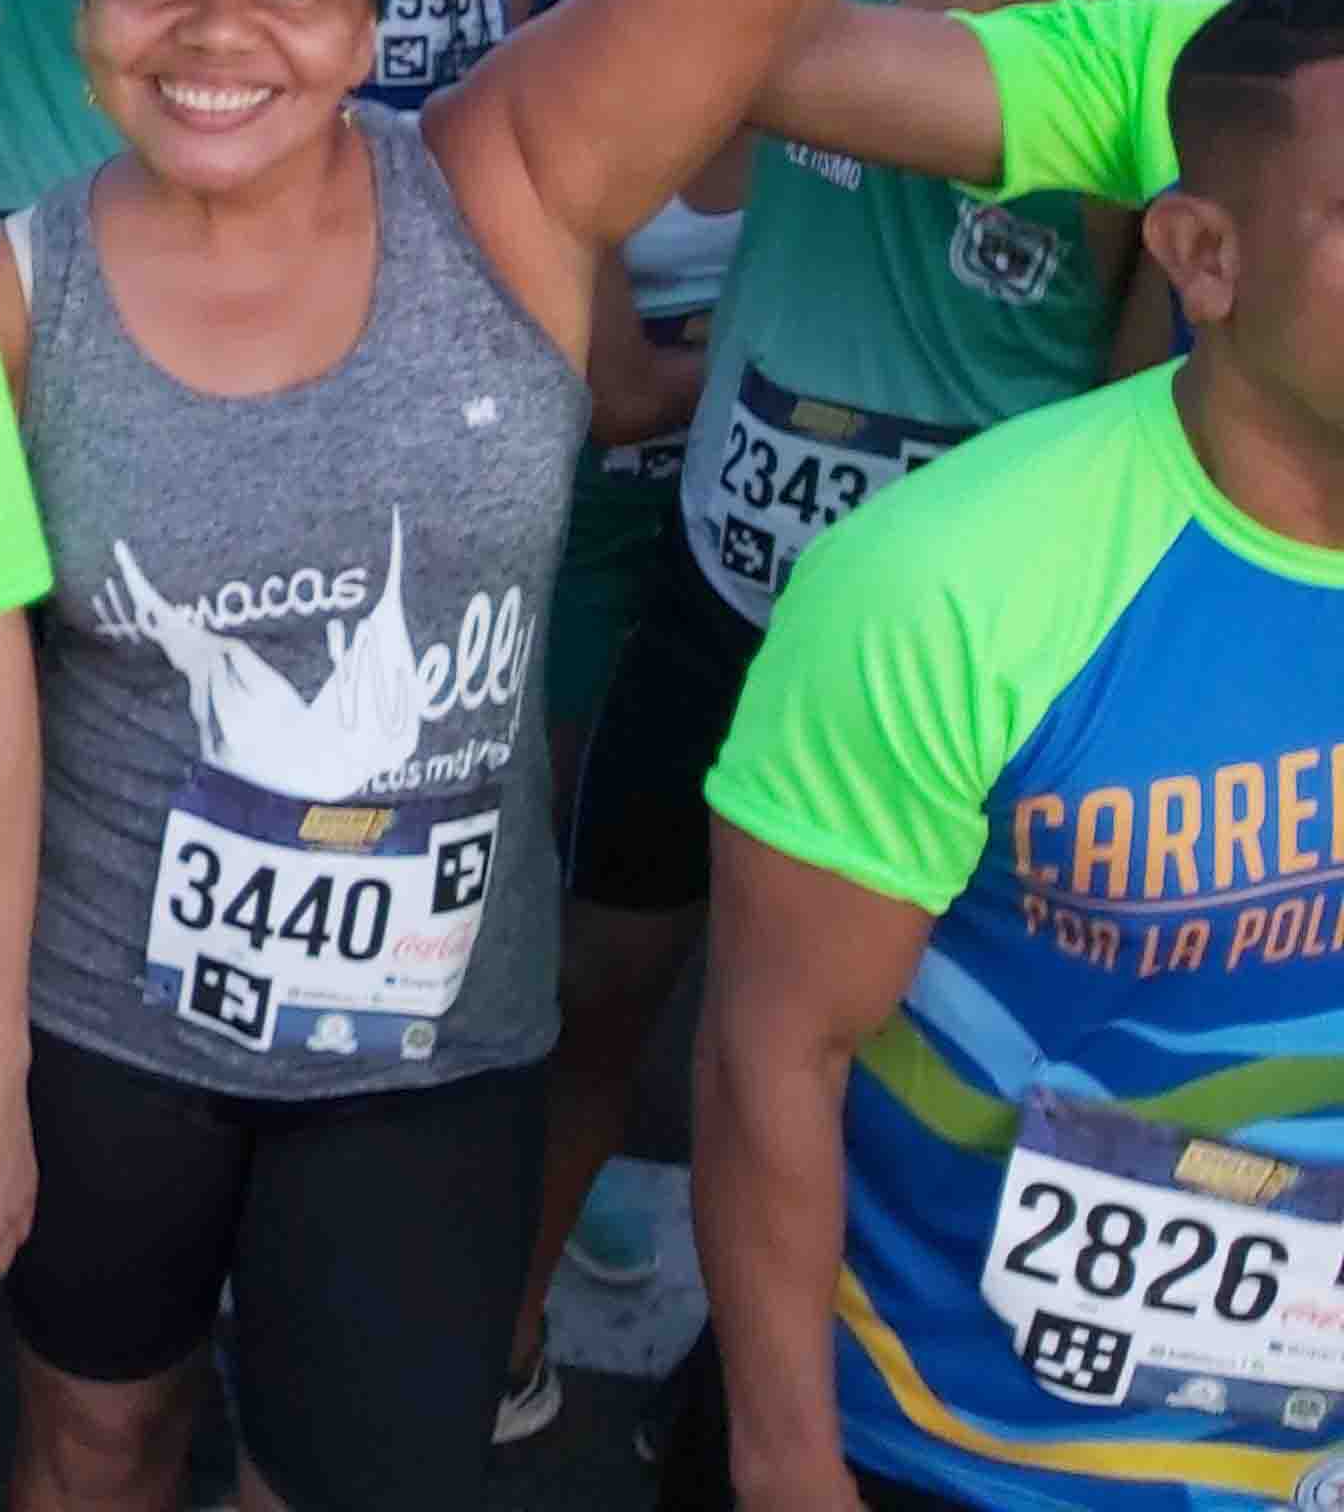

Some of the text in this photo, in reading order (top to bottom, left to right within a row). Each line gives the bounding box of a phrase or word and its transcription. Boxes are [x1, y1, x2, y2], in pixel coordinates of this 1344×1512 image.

[168, 840, 393, 962] 3440
[1137, 922, 1211, 979] LA
[1004, 1180, 1290, 1324] 2826
